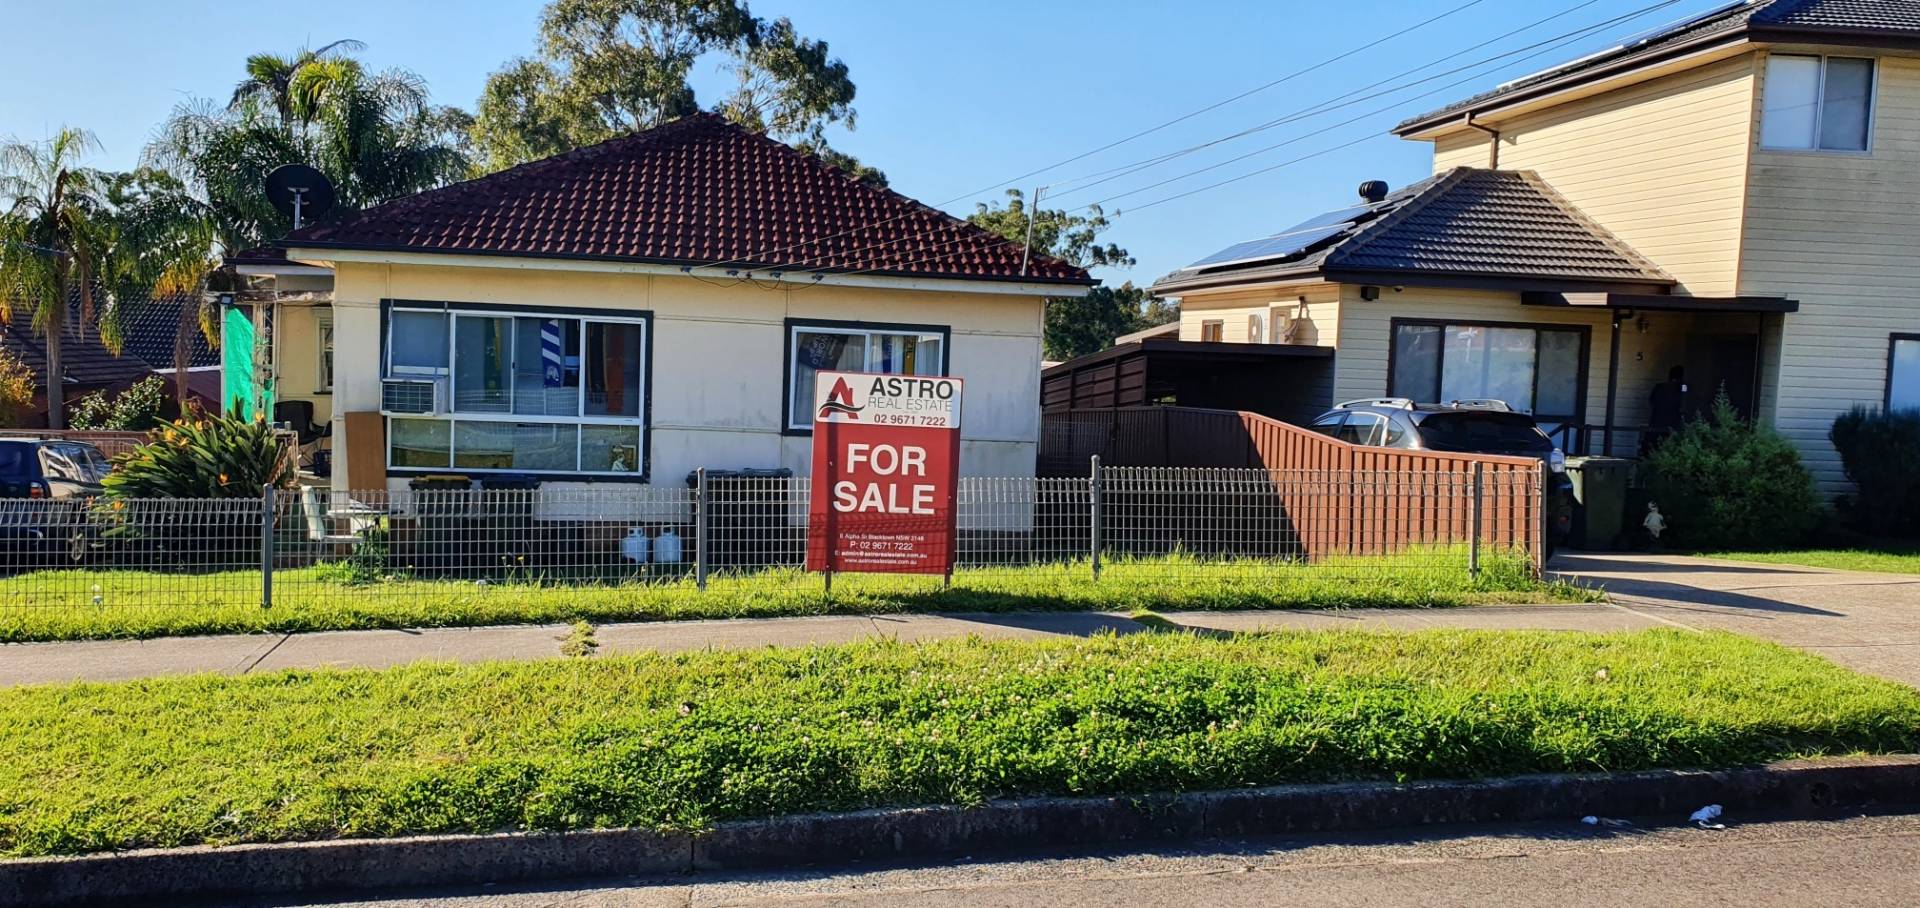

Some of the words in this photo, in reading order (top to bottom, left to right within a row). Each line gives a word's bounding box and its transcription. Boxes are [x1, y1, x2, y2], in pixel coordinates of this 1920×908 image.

[1636, 352, 1643, 361] 5
[869, 377, 954, 399] ASTRO
[868, 397, 902, 409] REAL
[906, 399, 953, 412] ESTATE
[874, 414, 887, 423] 02
[890, 414, 915, 424] 9671
[920, 416, 946, 426] 7222
[847, 443, 926, 476] FOR
[833, 480, 935, 515] SALE
[860, 541, 870, 549] 02
[872, 542, 891, 550] 9671
[894, 542, 913, 551] 7222
[841, 551, 928, 559] admin@astrorealestate.com.au
